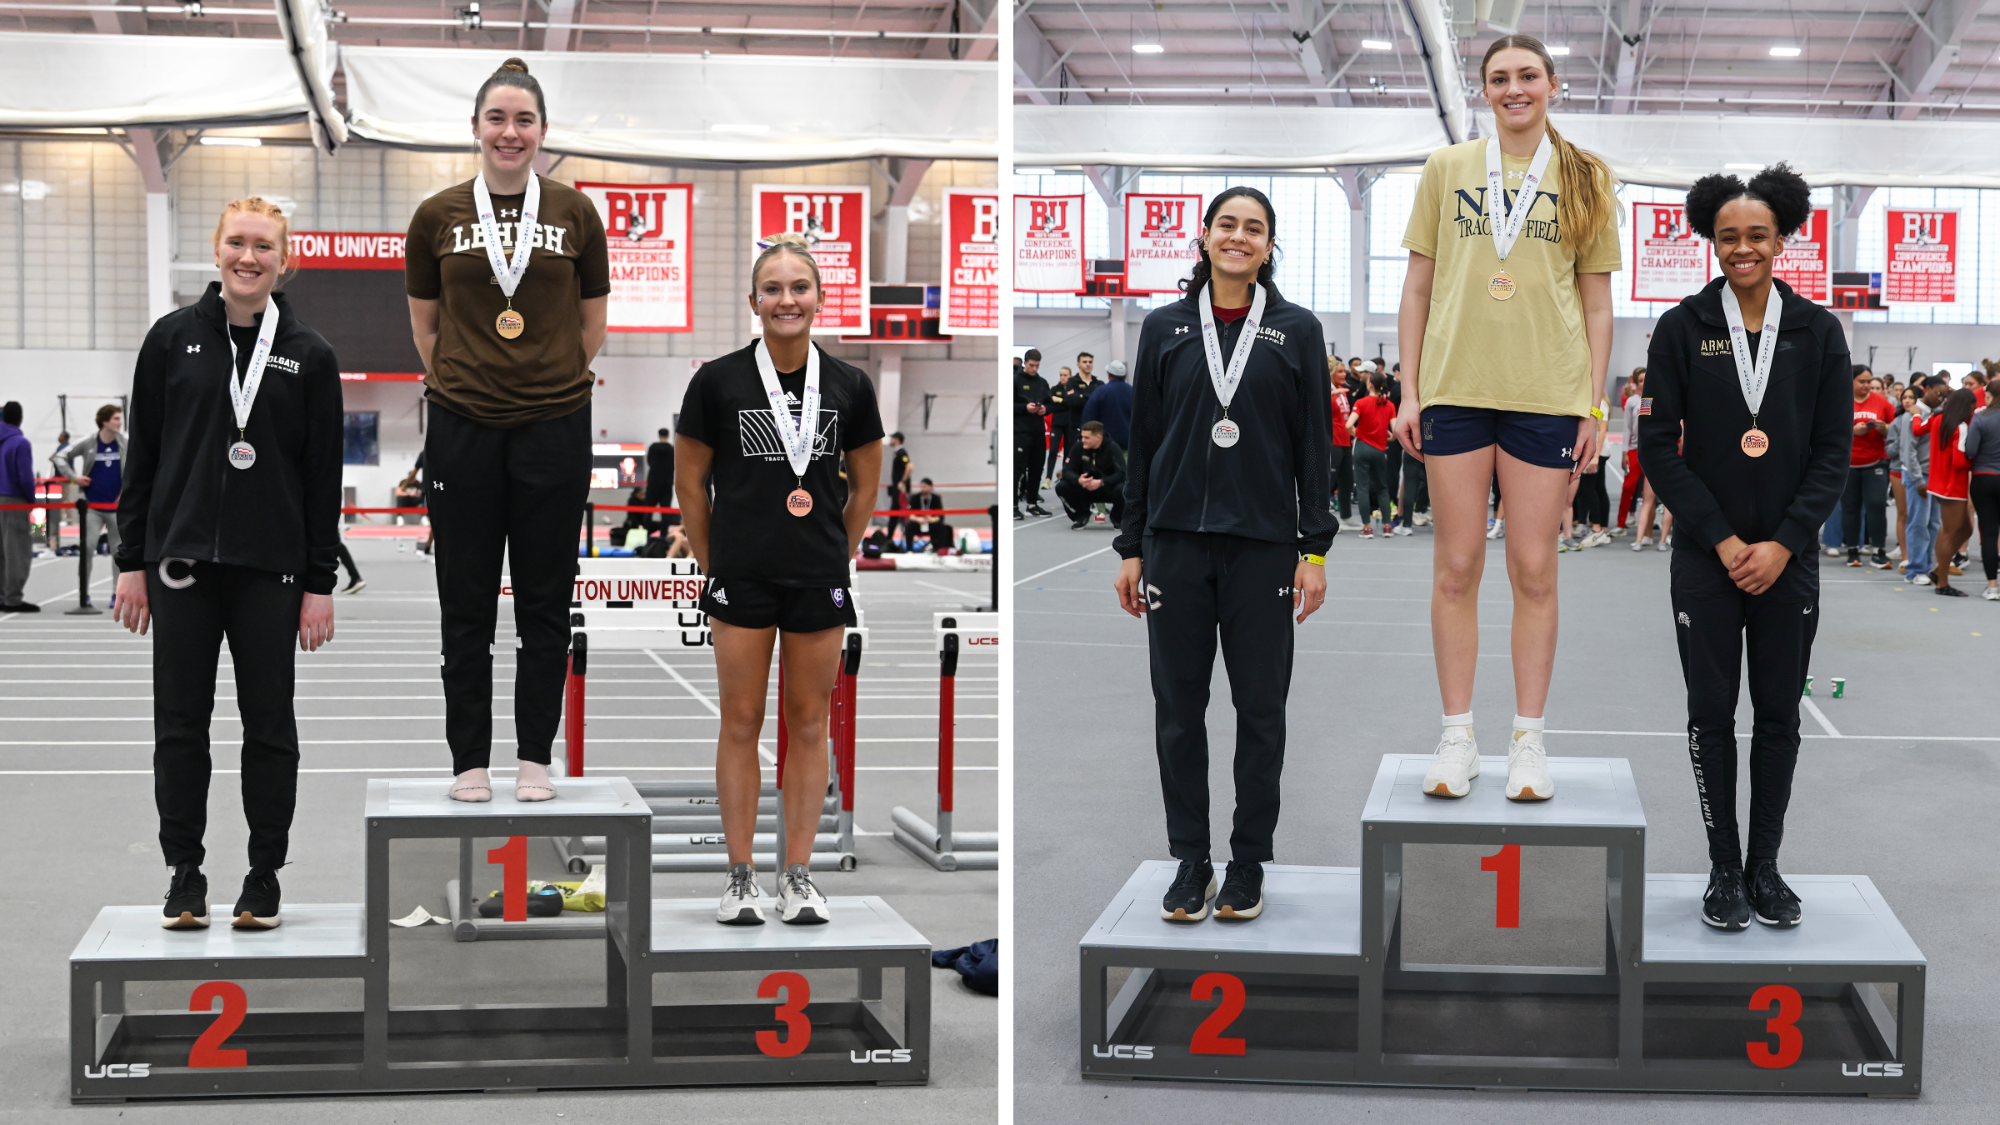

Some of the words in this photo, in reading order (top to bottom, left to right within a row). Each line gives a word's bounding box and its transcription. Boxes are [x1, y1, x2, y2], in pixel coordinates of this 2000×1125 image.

[605, 191, 667, 239] BU
[783, 195, 843, 241] BU
[971, 197, 998, 242] B
[1030, 201, 1068, 230] BU
[1145, 201, 1185, 230] BU
[1902, 213, 1944, 244] BU
[1025, 240, 1072, 248] CONFERENCE
[1458, 218, 1493, 238] TRAC
[1526, 219, 1562, 244] FIELD
[1019, 249, 1077, 259] CHAMPIONS
[1130, 249, 1196, 259] APPEARANCES
[1641, 257, 1703, 268] CHAMPIONS
[1646, 247, 1698, 256] CONFERENCE
[1895, 251, 1947, 262] CONFERENCE
[610, 266, 680, 281] AMPIONS
[1890, 261, 1953, 273] CHAMPIONS
[1701, 340, 1731, 352] ARMY
[268, 355, 300, 371] OLGATE
[159, 556, 197, 589] C
[968, 637, 998, 645] UCS
[1690, 726, 1700, 758] POINT
[1694, 763, 1706, 793] WEST
[1701, 797, 1715, 828] ARMY
[487, 836, 527, 922] 1
[1481, 844, 1520, 928] 1
[188, 981, 247, 1068] 2
[755, 971, 811, 1058] 3
[1190, 972, 1246, 1055] 2
[1746, 984, 1803, 1069] 3
[851, 1049, 911, 1063] UCS
[1093, 1044, 1154, 1059] UCS
[84, 1063, 150, 1078] UCS
[1841, 1063, 1904, 1077] UCS
